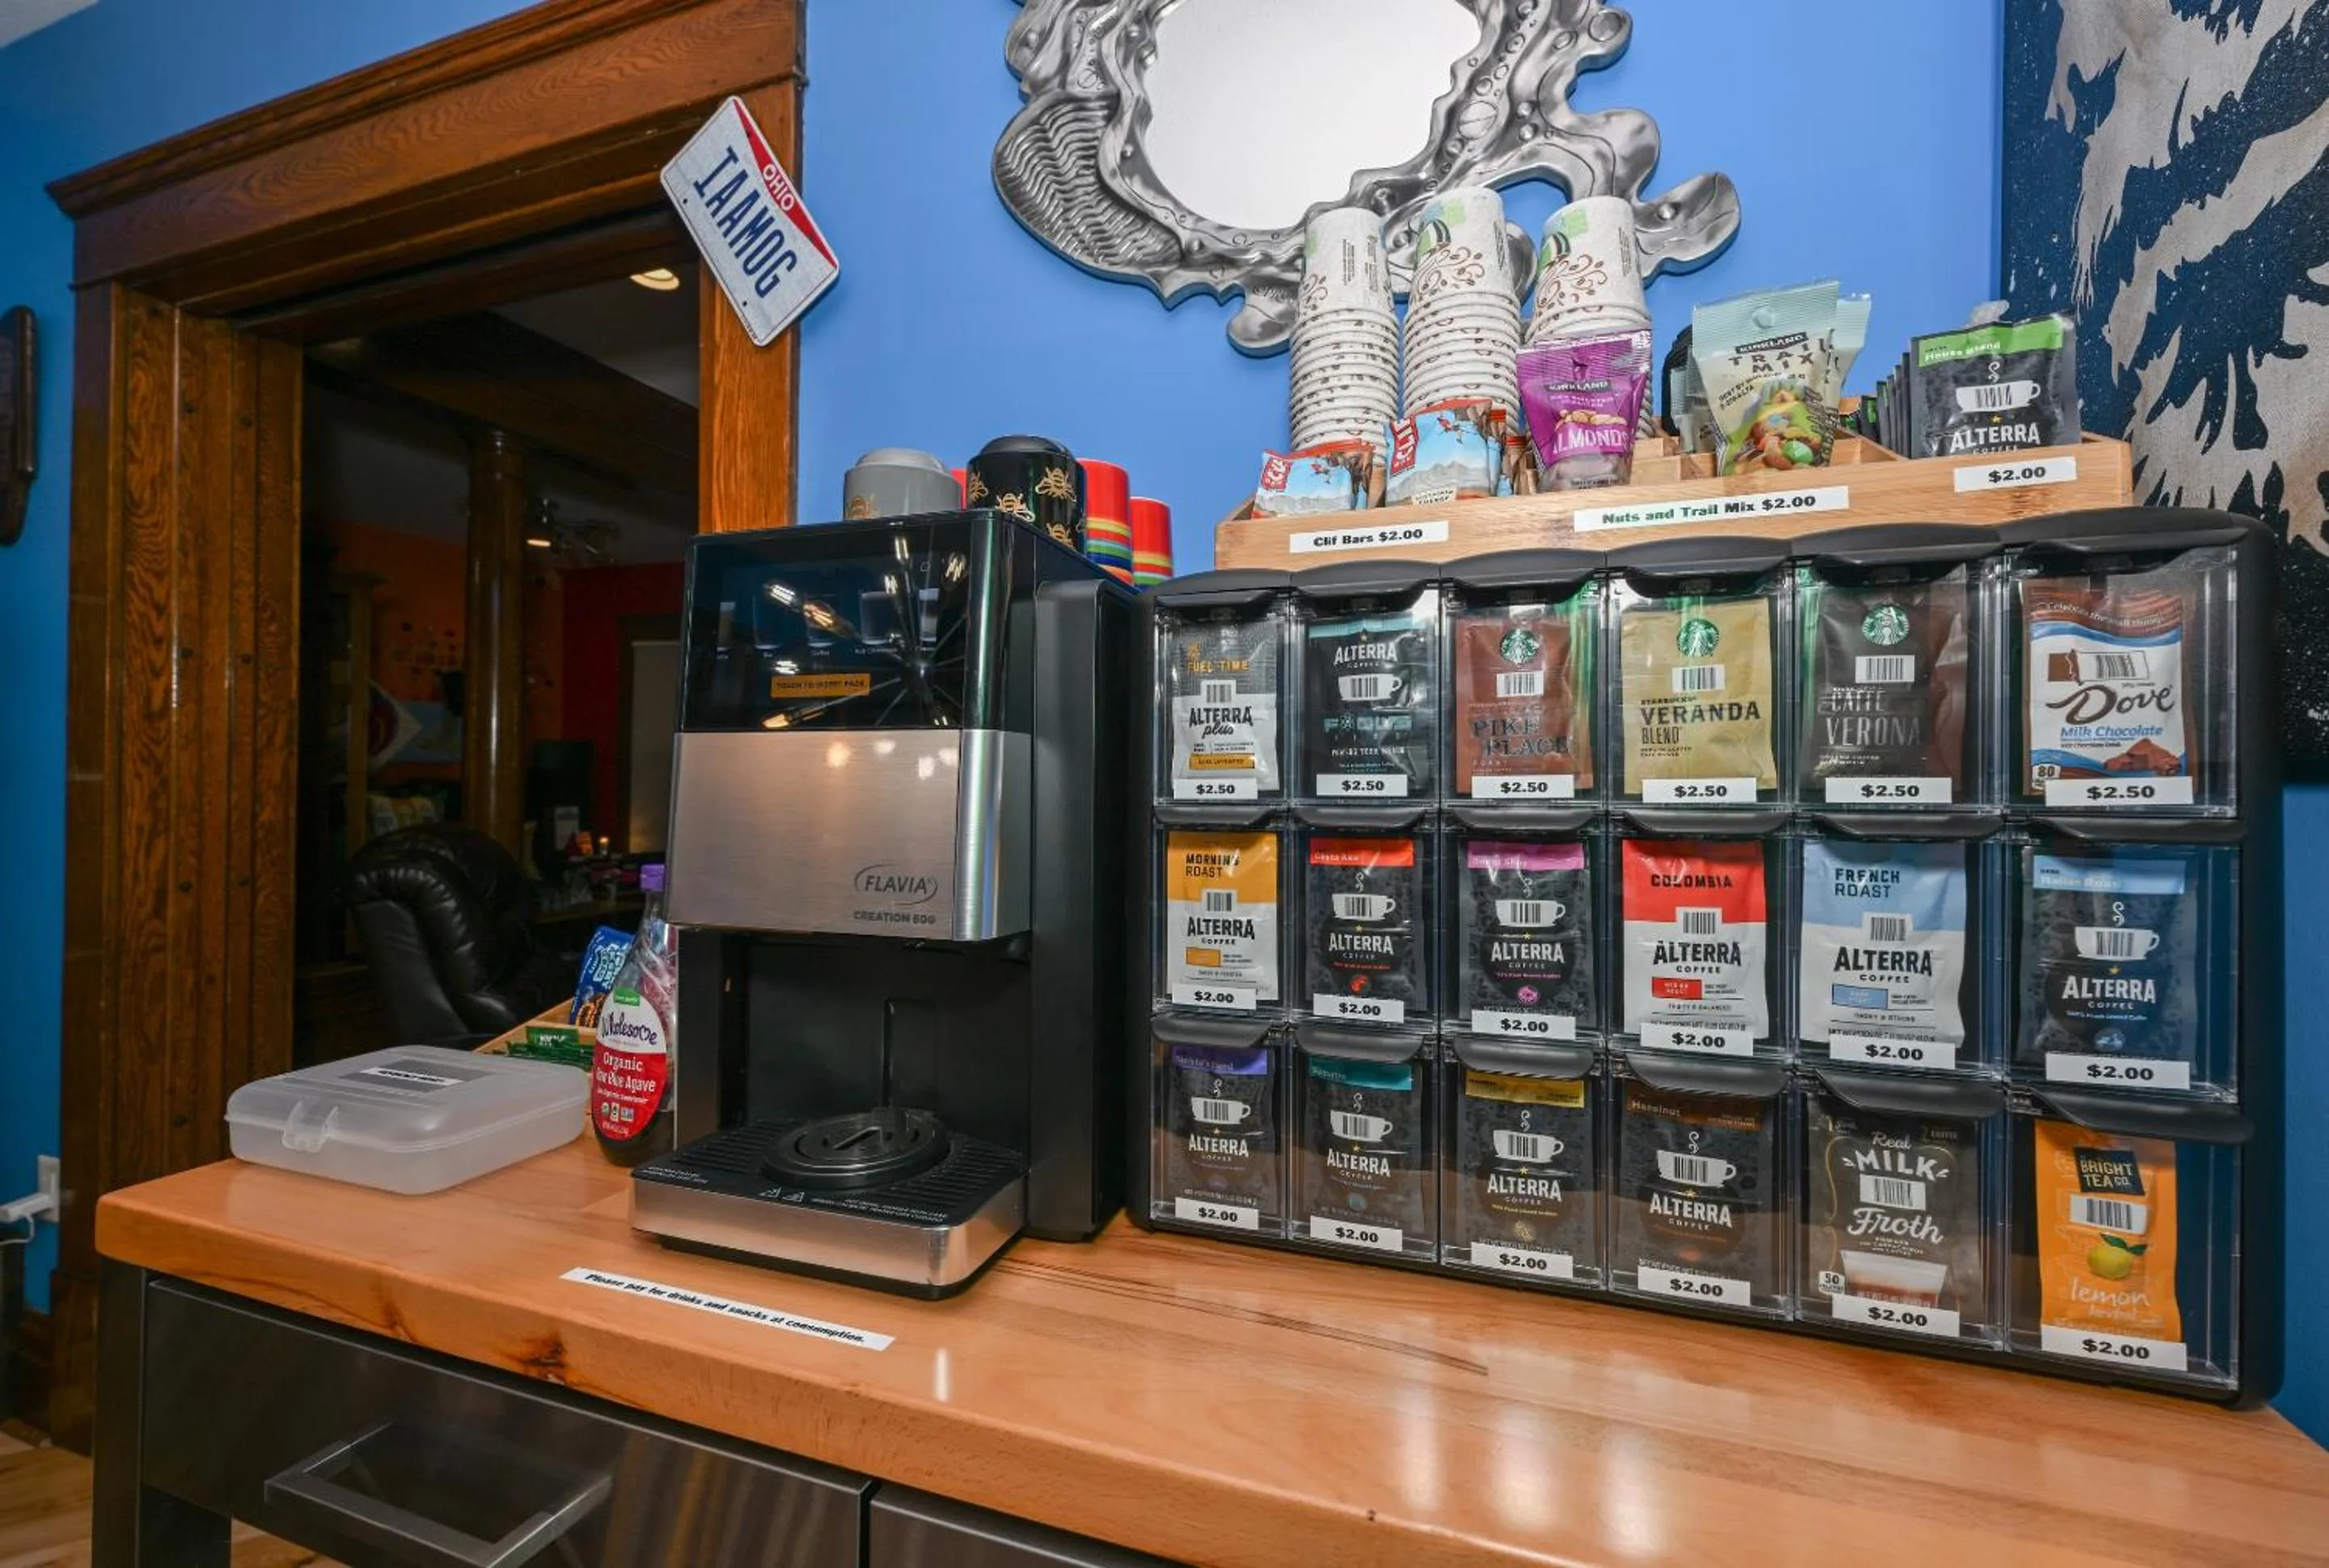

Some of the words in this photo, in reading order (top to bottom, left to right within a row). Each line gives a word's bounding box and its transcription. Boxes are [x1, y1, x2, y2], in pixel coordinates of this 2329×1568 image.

[763, 164, 795, 211] OHIO
[693, 145, 797, 298] IAAMOG
[1752, 353, 1814, 373] MIX
[1950, 422, 2040, 454] ALTERRA
[1989, 467, 2046, 484] $2.00
[1603, 511, 1639, 525] Nuts
[1646, 509, 1675, 521] and
[1680, 504, 1718, 519] Trail
[1724, 500, 1755, 514] Mix
[1762, 495, 1815, 511] $2.00
[1313, 535, 1338, 547] Clif
[1342, 532, 1374, 544] Bars
[1379, 529, 1423, 542] $2.00
[1334, 642, 1397, 665] ALTERRA
[1641, 701, 1760, 725] VERANDA
[2045, 684, 2175, 725] Dove
[1189, 706, 1253, 727] ALTERRA
[1202, 722, 1233, 738] plus
[1642, 726, 1680, 744] BLEND
[1827, 716, 1921, 746] VERONA
[2061, 726, 2092, 739] Milk
[2095, 725, 2163, 737] Chocolate
[1486, 736, 1568, 756] PLACE
[2037, 766, 2055, 777] 80
[1196, 784, 1235, 795] $2.50
[1342, 780, 1384, 792] $2.50
[1501, 782, 1548, 793] $2.50
[1675, 785, 1727, 797] $2.50
[1861, 784, 1920, 797] $2.50
[2086, 786, 2156, 800] $2.50
[1186, 866, 1223, 877] ROAST
[1836, 867, 1900, 883] FRENCH
[864, 875, 928, 894] FLAVIA
[1651, 874, 1733, 888] COLOMBIA
[1834, 883, 1892, 898] ROAST
[853, 911, 910, 923] CREATION
[1187, 917, 1255, 940] ALTERRA
[1329, 932, 1394, 956] ALTERRA
[1490, 941, 1566, 964] ALTERRA
[1653, 941, 1741, 966] ALTERRA
[1834, 946, 1933, 977] ALTERRA
[1676, 965, 1721, 974] COFFEE
[1860, 974, 1909, 983] COFFEE
[1194, 991, 1234, 1004] $2.00
[2061, 974, 2156, 1004] ALTERRA
[1338, 1003, 1381, 1016] $2.00
[1500, 1018, 1549, 1033] $2.00
[1672, 1032, 1725, 1048] $2.00
[603, 1052, 643, 1071] Organic
[1865, 1045, 1923, 1060] $2.00
[2086, 1064, 2154, 1081] $2.00
[625, 1076, 656, 1093] Agave
[1189, 1133, 1249, 1158] ALTERRA
[1871, 1132, 1912, 1150] Real
[1326, 1148, 1391, 1178] ALTERRA
[1855, 1149, 1938, 1181] MILK
[2080, 1159, 2132, 1177] BRIGHT
[1487, 1173, 1562, 1202] ALTERRA
[2083, 1175, 2113, 1188] TEA
[1198, 1207, 1238, 1222] $2.00
[1650, 1192, 1732, 1228] ALTERRA
[1846, 1207, 1944, 1245] Froth
[1336, 1228, 1379, 1243] $2.00
[1499, 1254, 1547, 1270] $2.00
[1670, 1278, 1722, 1297] $2.00
[1824, 1273, 1840, 1285] 50
[2071, 1277, 2150, 1307] lemon
[585, 1274, 624, 1287] Please
[623, 1282, 647, 1292] pay
[649, 1285, 666, 1296] for
[667, 1291, 702, 1305] drinks
[704, 1301, 728, 1311] and
[729, 1306, 767, 1321] snacks
[770, 1316, 784, 1325] at
[786, 1317, 865, 1342] consumption.
[1868, 1307, 1927, 1327] $2.00
[2082, 1338, 2149, 1359] $2.00
